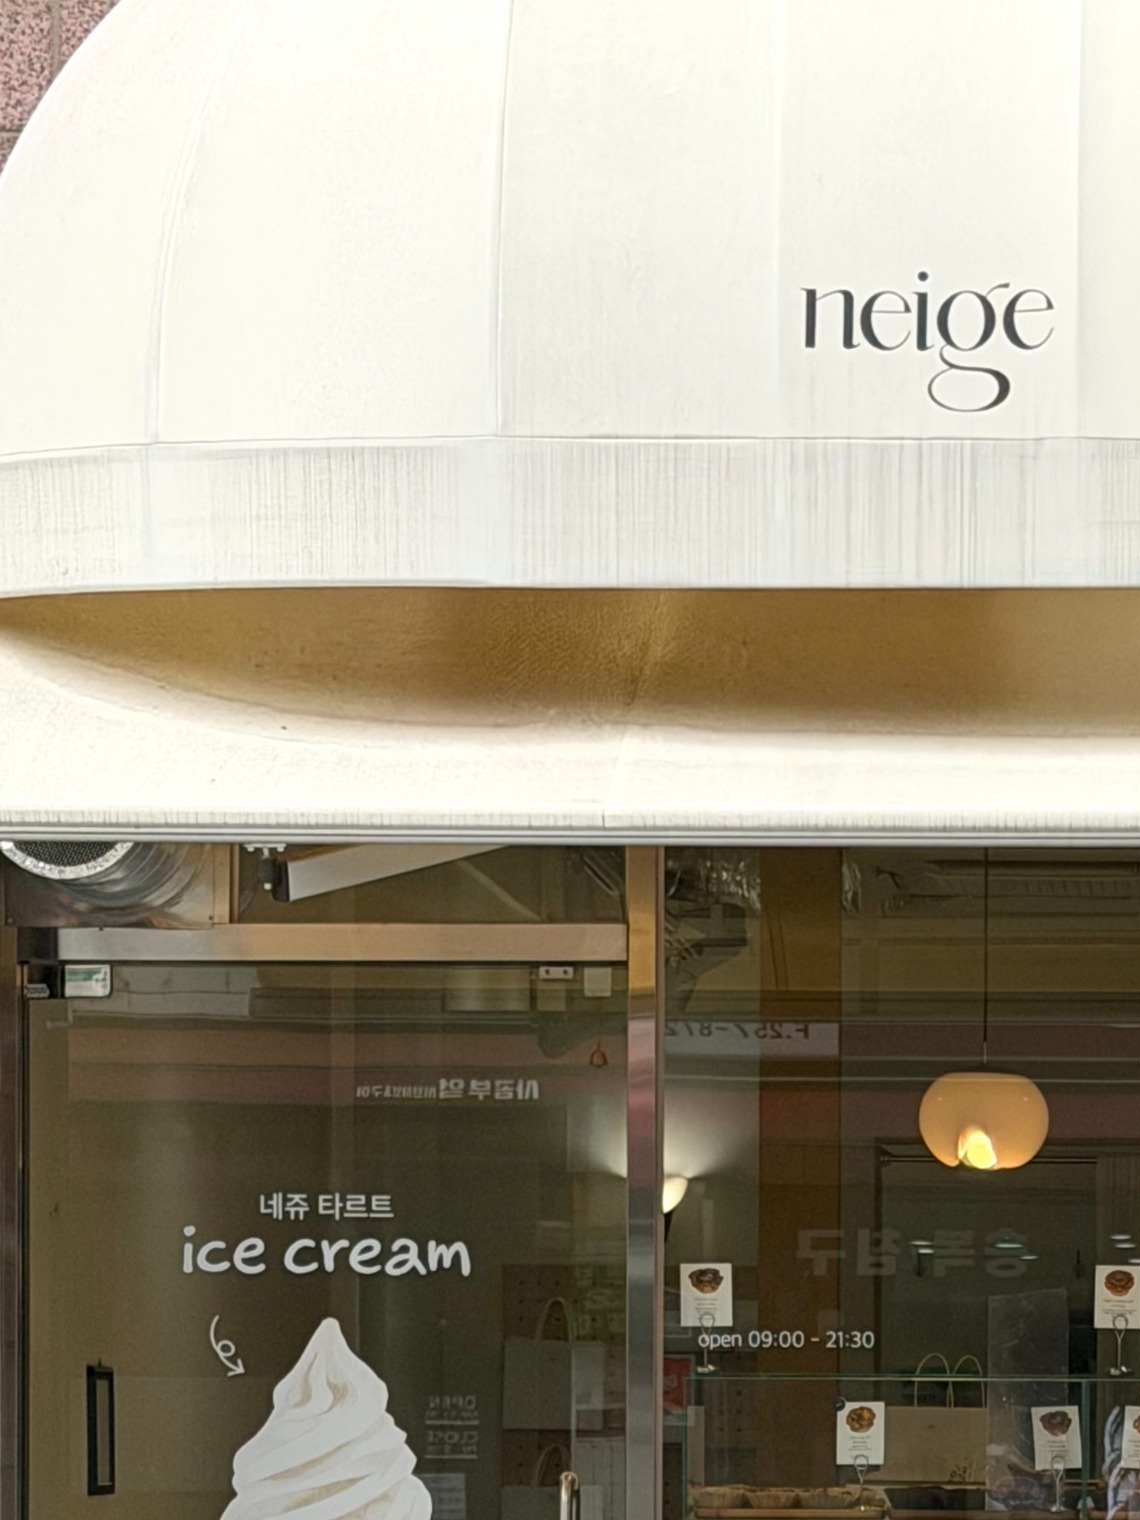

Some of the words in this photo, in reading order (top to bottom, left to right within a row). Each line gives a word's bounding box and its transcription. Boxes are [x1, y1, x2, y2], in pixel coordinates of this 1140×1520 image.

[800, 271, 1055, 413] neige
[259, 1192, 310, 1221] 네쥬
[317, 1192, 394, 1220] 타르트
[182, 1225, 267, 1275] ice
[283, 1236, 471, 1277] cream
[698, 1332, 743, 1352] open
[748, 1331, 805, 1349] 09:00
[825, 1331, 875, 1349] 21:30
